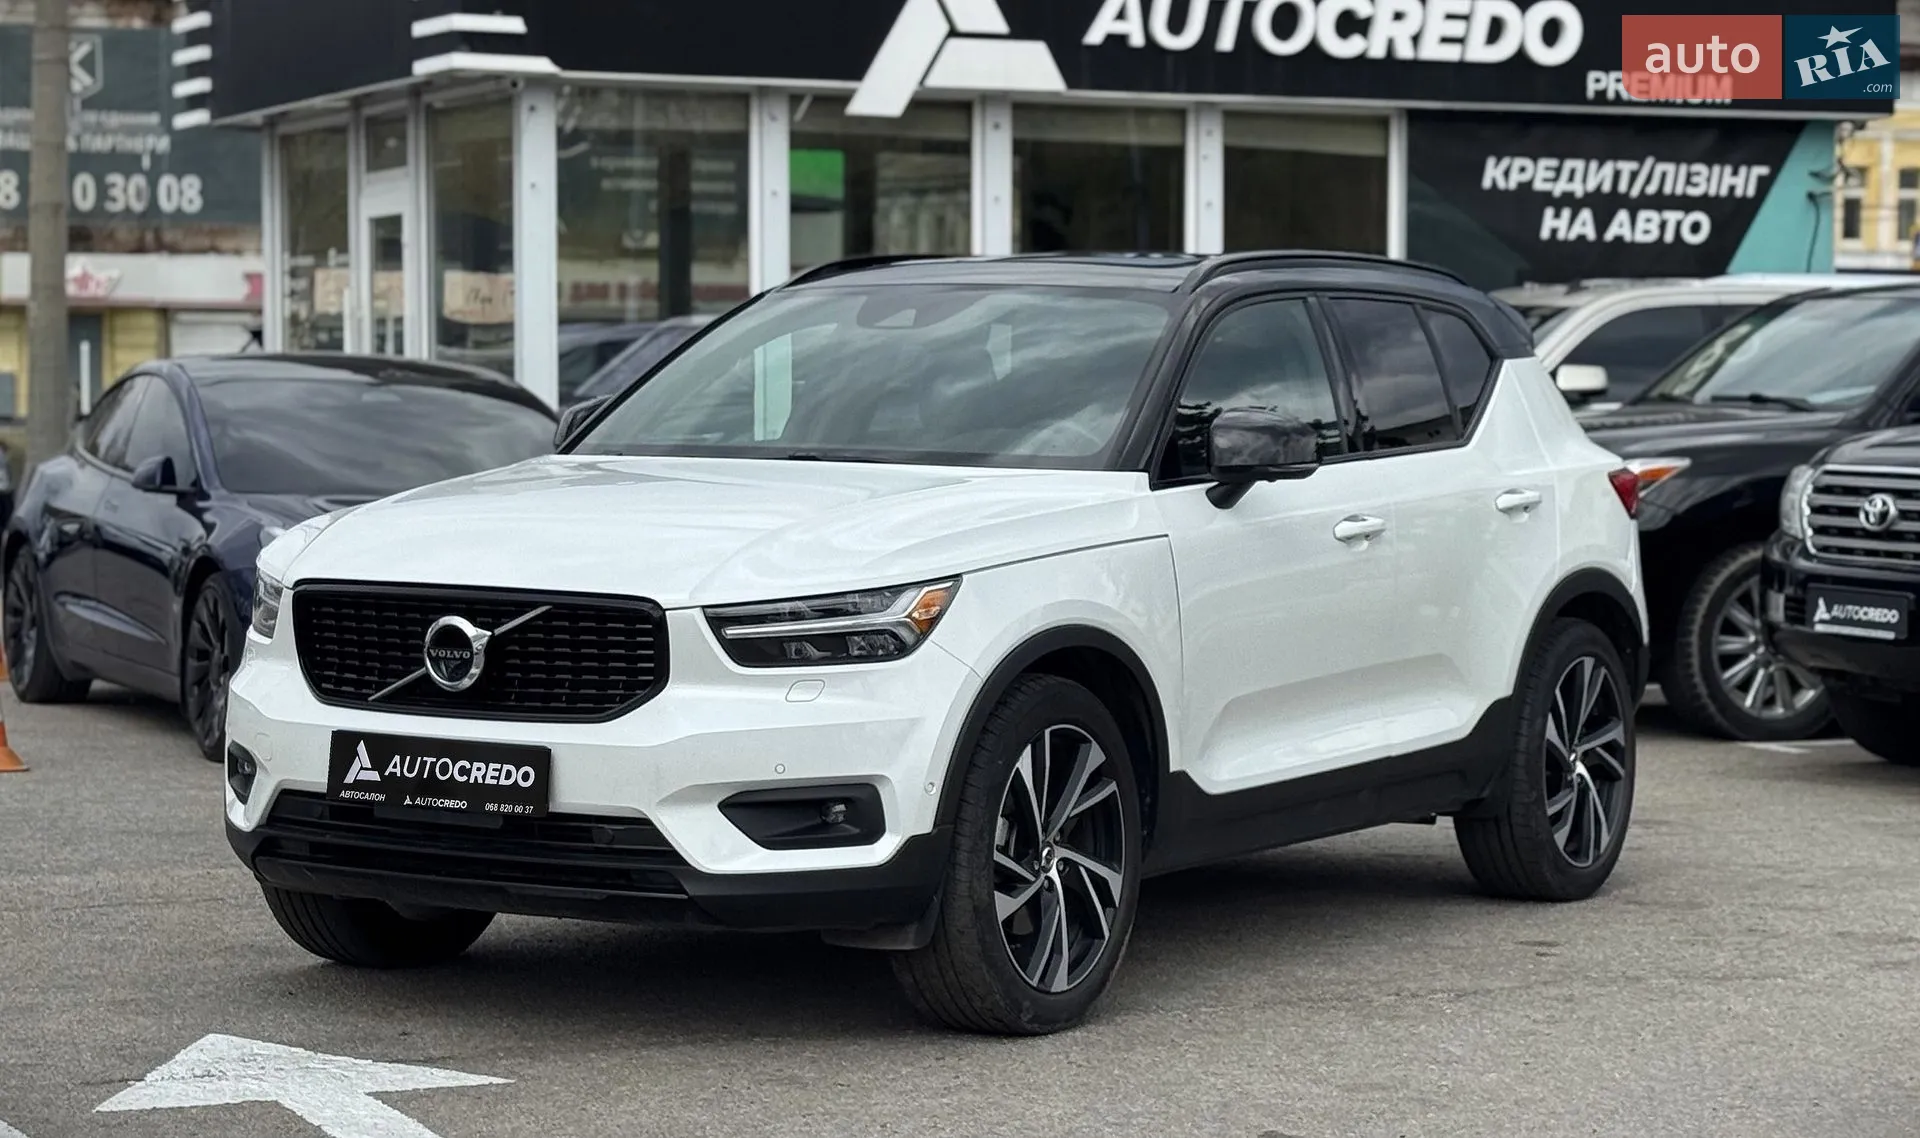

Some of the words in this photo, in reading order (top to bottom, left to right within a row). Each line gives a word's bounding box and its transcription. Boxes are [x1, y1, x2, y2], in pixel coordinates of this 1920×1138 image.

[1082, 0, 1584, 66] AUTOCREDO
[1586, 70, 1734, 104] PREMIUM
[103, 172, 149, 213] 30
[156, 173, 204, 214] 08
[1481, 155, 1771, 199] КРЕДИТ/ЛІЗІНГ
[1539, 206, 1597, 242] НА
[1603, 208, 1712, 246] АВТО
[1830, 604, 1900, 624] AUTOCREDO
[429, 648, 471, 659] VOLVO
[384, 755, 535, 788] AUTOCREDO
[339, 789, 386, 802] АВТОСАЛОН
[414, 797, 468, 809] AUTOCREDO
[484, 802, 499, 811] 068
[499, 803, 513, 813] 820
[524, 805, 534, 814] 37
